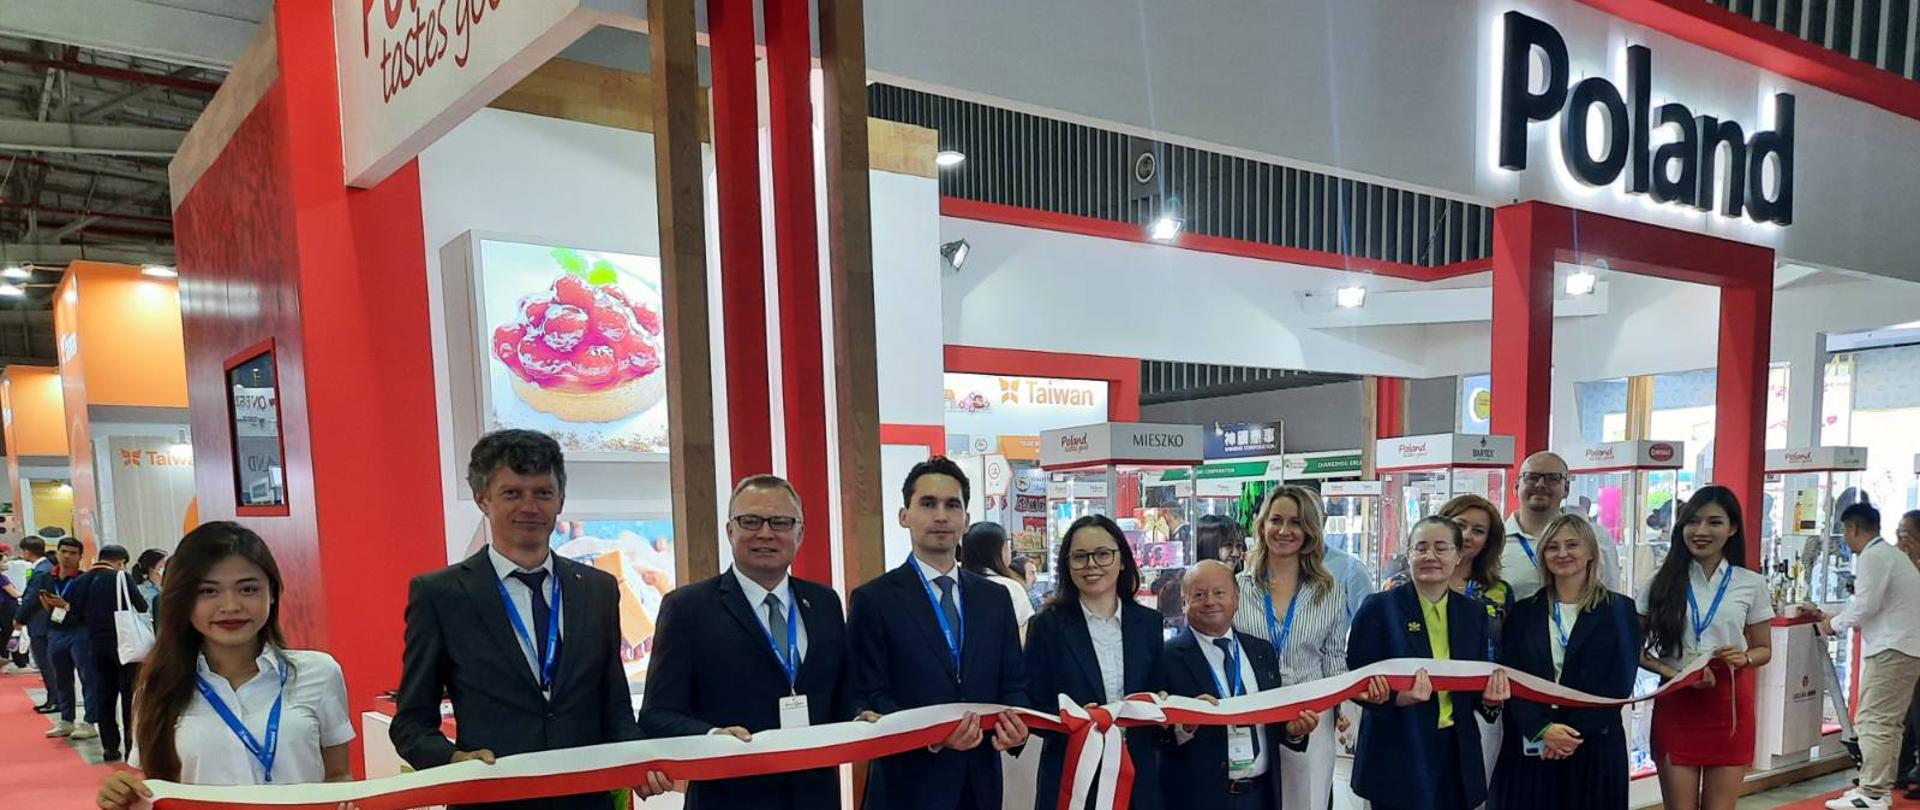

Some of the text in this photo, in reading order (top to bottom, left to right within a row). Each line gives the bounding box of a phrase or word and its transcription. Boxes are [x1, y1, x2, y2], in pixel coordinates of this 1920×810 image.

[381, 0, 448, 103] tastes
[1499, 10, 1795, 226] Poland
[1025, 381, 1094, 407] Taiwan
[1061, 432, 1087, 447] Poland
[1133, 434, 1184, 447] MIESZKO
[1399, 442, 1426, 453] Poland
[1585, 448, 1613, 457] Poland
[146, 451, 194, 466] Taiwa
[1785, 451, 1812, 461] Poland
